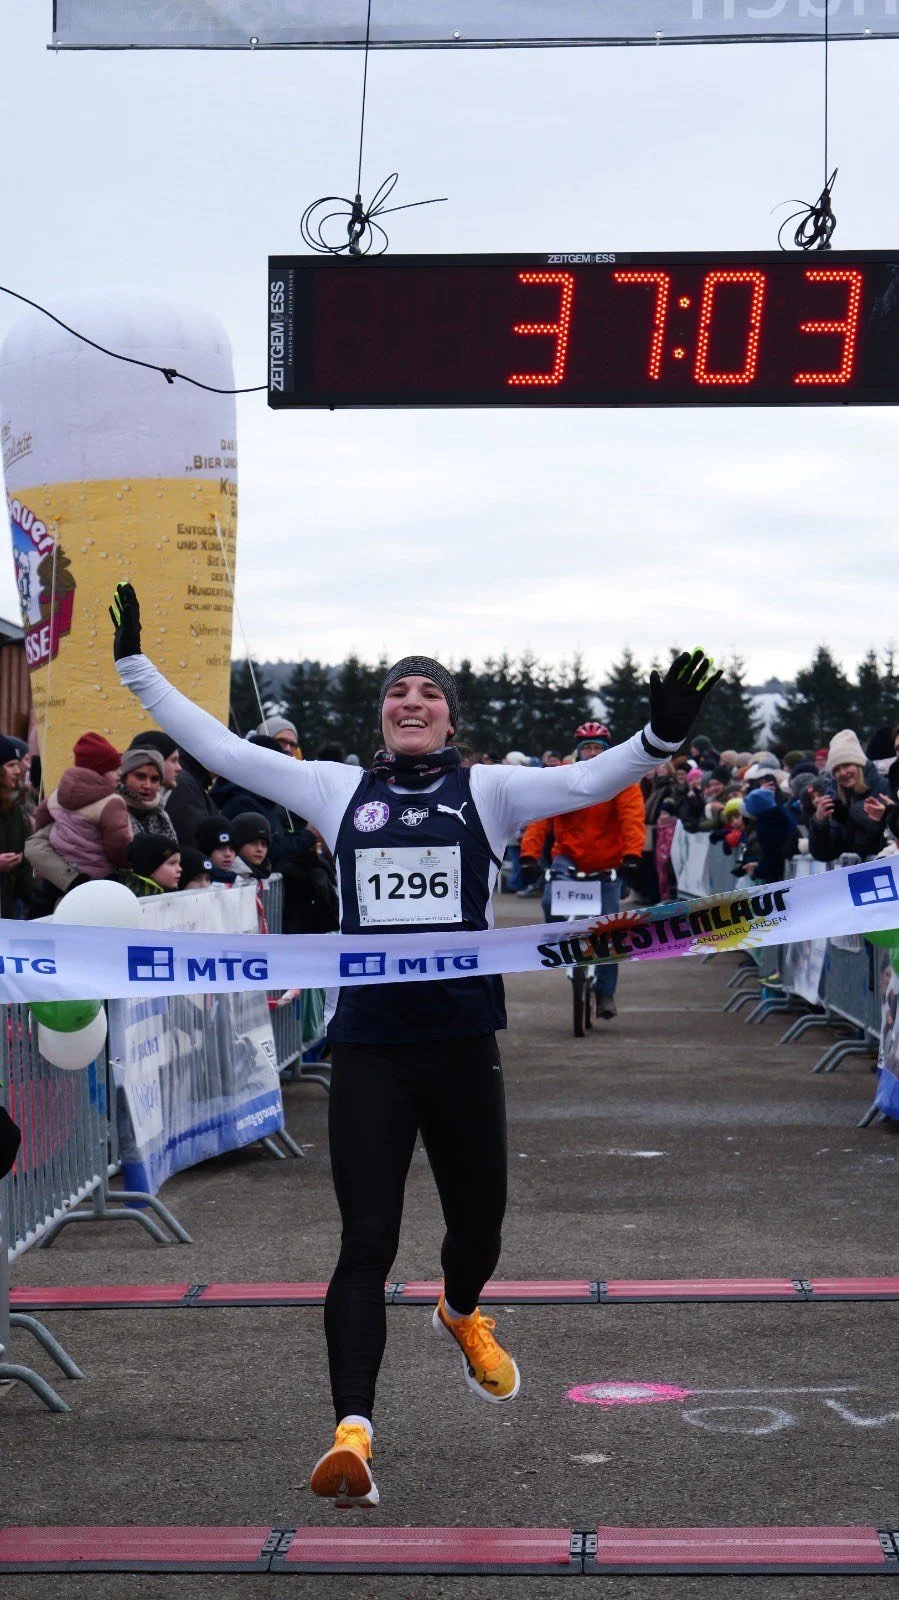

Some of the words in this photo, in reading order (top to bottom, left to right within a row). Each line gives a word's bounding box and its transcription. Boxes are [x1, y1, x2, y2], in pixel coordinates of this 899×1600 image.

[367, 872, 449, 900] 1296
[556, 891, 565, 900] 1.
[568, 891, 593, 900] Frau
[689, 915, 788, 946] SANDHARLANDEN
[187, 957, 269, 982] MTG
[398, 954, 478, 975] MTG
